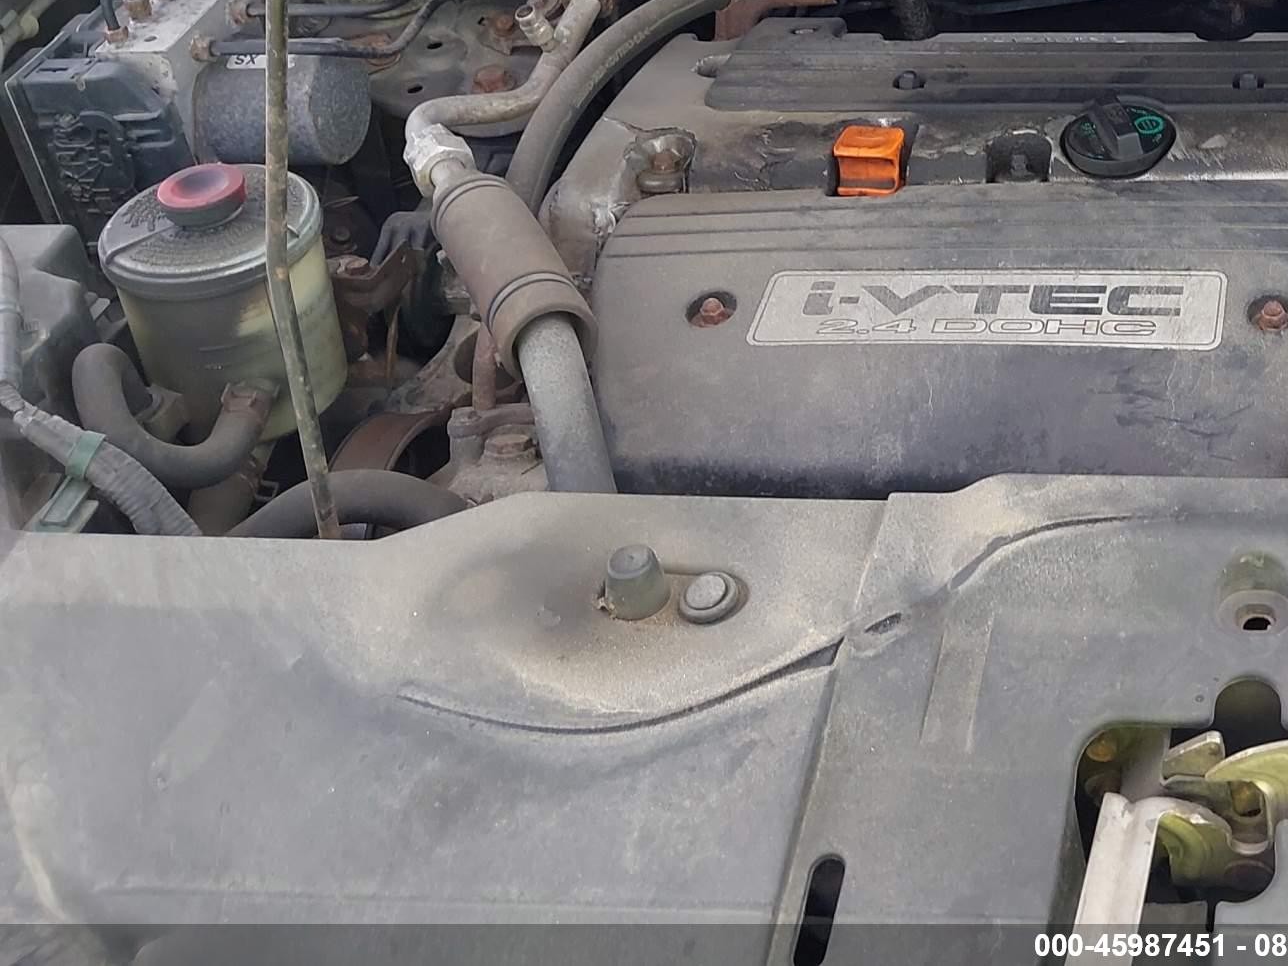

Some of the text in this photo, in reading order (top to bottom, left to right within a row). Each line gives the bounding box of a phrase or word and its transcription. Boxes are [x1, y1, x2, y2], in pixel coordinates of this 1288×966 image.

[802, 281, 1184, 316] i-VTEC
[816, 318, 1157, 336] 2.4 DOHC
